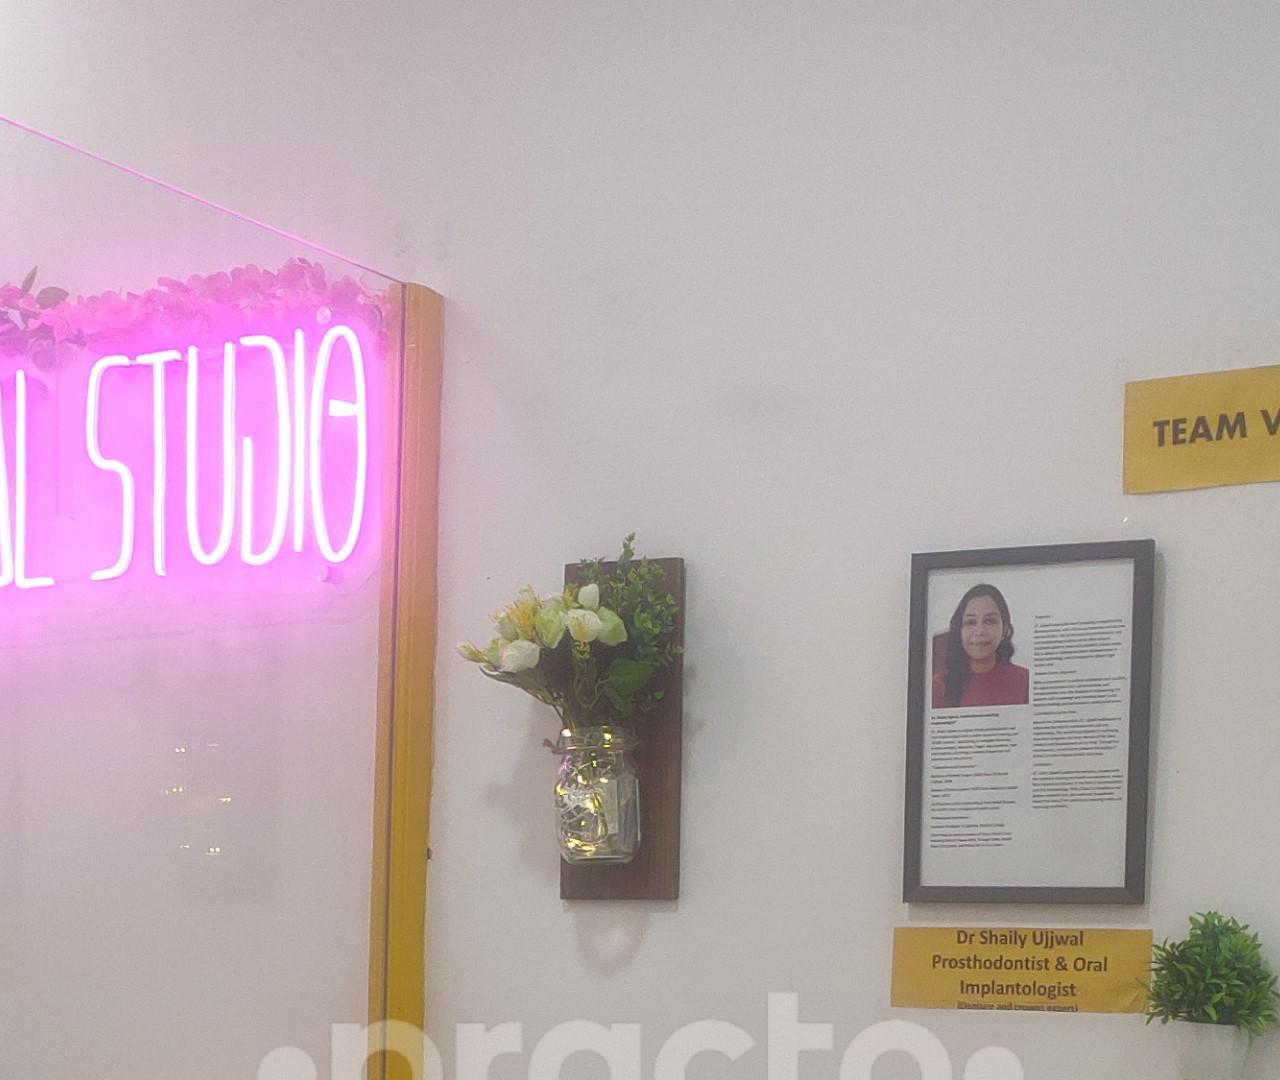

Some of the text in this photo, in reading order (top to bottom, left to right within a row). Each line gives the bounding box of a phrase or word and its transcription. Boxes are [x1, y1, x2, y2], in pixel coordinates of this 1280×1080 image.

[1152, 411, 1248, 448] TEAM
[87, 324, 369, 580] STUDIO
[956, 929, 1084, 949] Dr Shaily Ujjwal
[932, 953, 1108, 973] Prosthodontist & Oral
[959, 979, 1077, 1000] Implantologist
